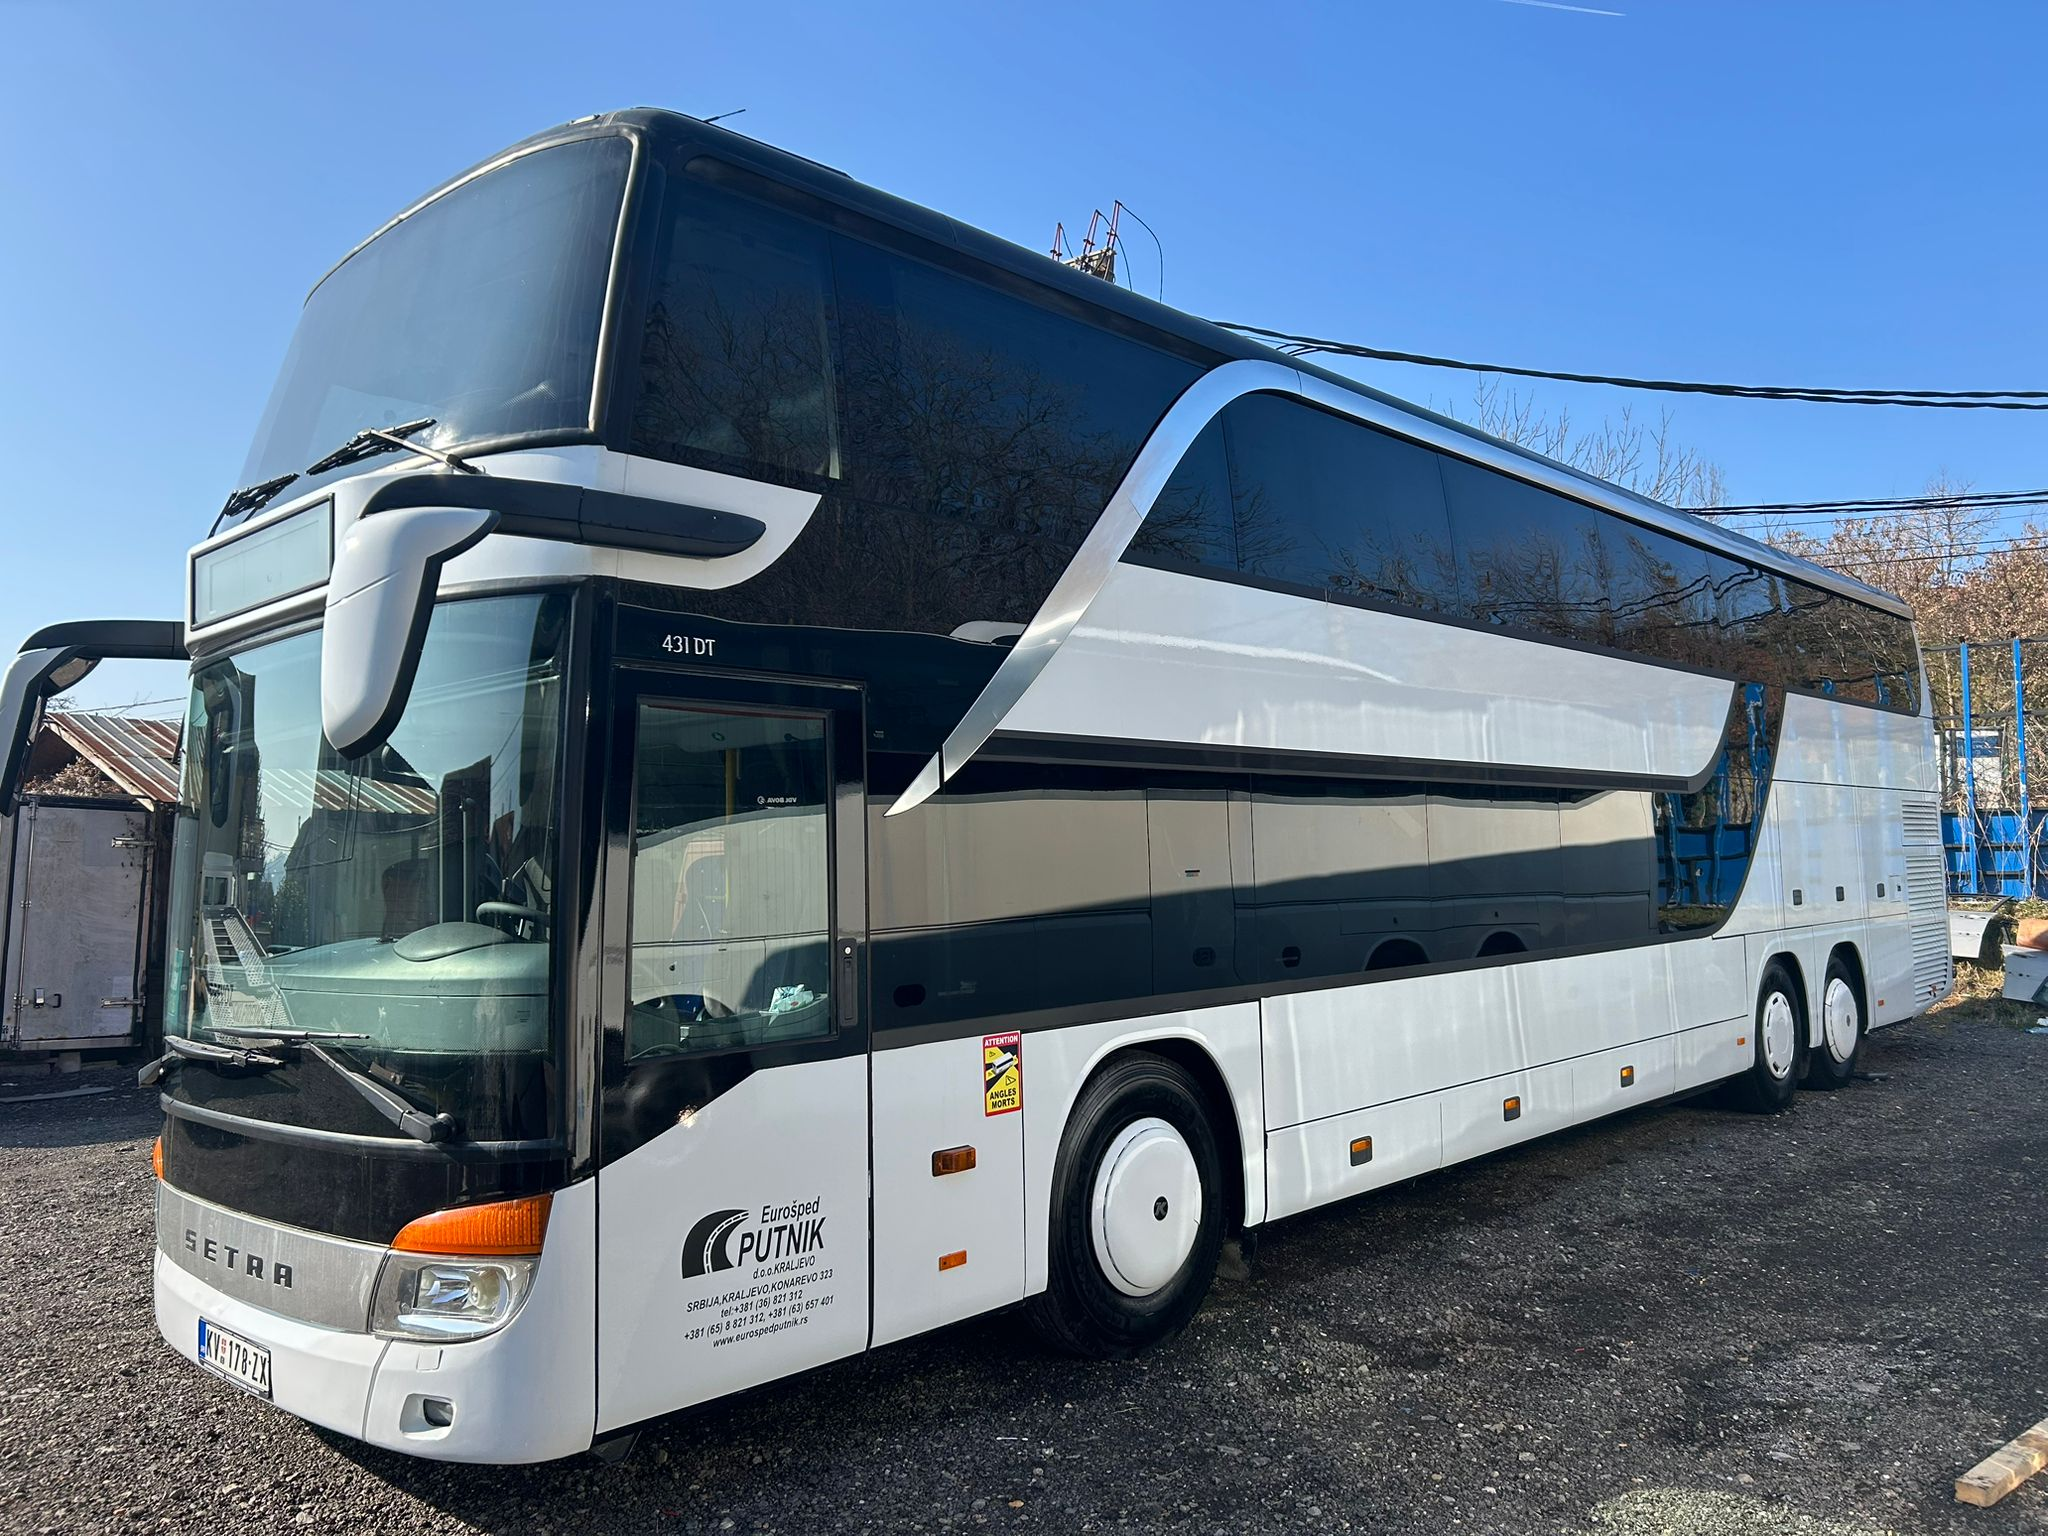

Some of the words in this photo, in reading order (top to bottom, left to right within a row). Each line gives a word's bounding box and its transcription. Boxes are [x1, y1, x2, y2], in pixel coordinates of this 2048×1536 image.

[661, 634, 689, 654] 431
[693, 637, 716, 656] DT
[984, 1035, 1018, 1047] ATTENTION
[990, 1088, 1016, 1100] ANGLES
[991, 1097, 1015, 1109] MORTS
[761, 1196, 821, 1224] Eurošped
[737, 1217, 827, 1268] PUTNIK
[185, 1228, 293, 1289] SETRA
[752, 1255, 816, 1280] d.o.o.KRALJEVO
[686, 1271, 818, 1313] SRBIJA,KRALJEVO,KONAREVO
[819, 1268, 834, 1282] 323
[720, 1300, 753, 1319] tel:+381
[755, 1298, 771, 1312] (36)
[772, 1293, 787, 1306] 821
[789, 1289, 803, 1302] 312
[684, 1327, 705, 1342] +381
[706, 1321, 723, 1338] (65)
[725, 1320, 731, 1331] 8
[732, 1316, 747, 1329] 821
[749, 1312, 766, 1325] 312,
[767, 1307, 787, 1320] +381
[788, 1302, 804, 1317] (63)
[805, 1298, 819, 1311] 657
[820, 1295, 834, 1307] 401
[712, 1315, 809, 1348] www.eurospedputnik.rs
[206, 1328, 221, 1361] KV
